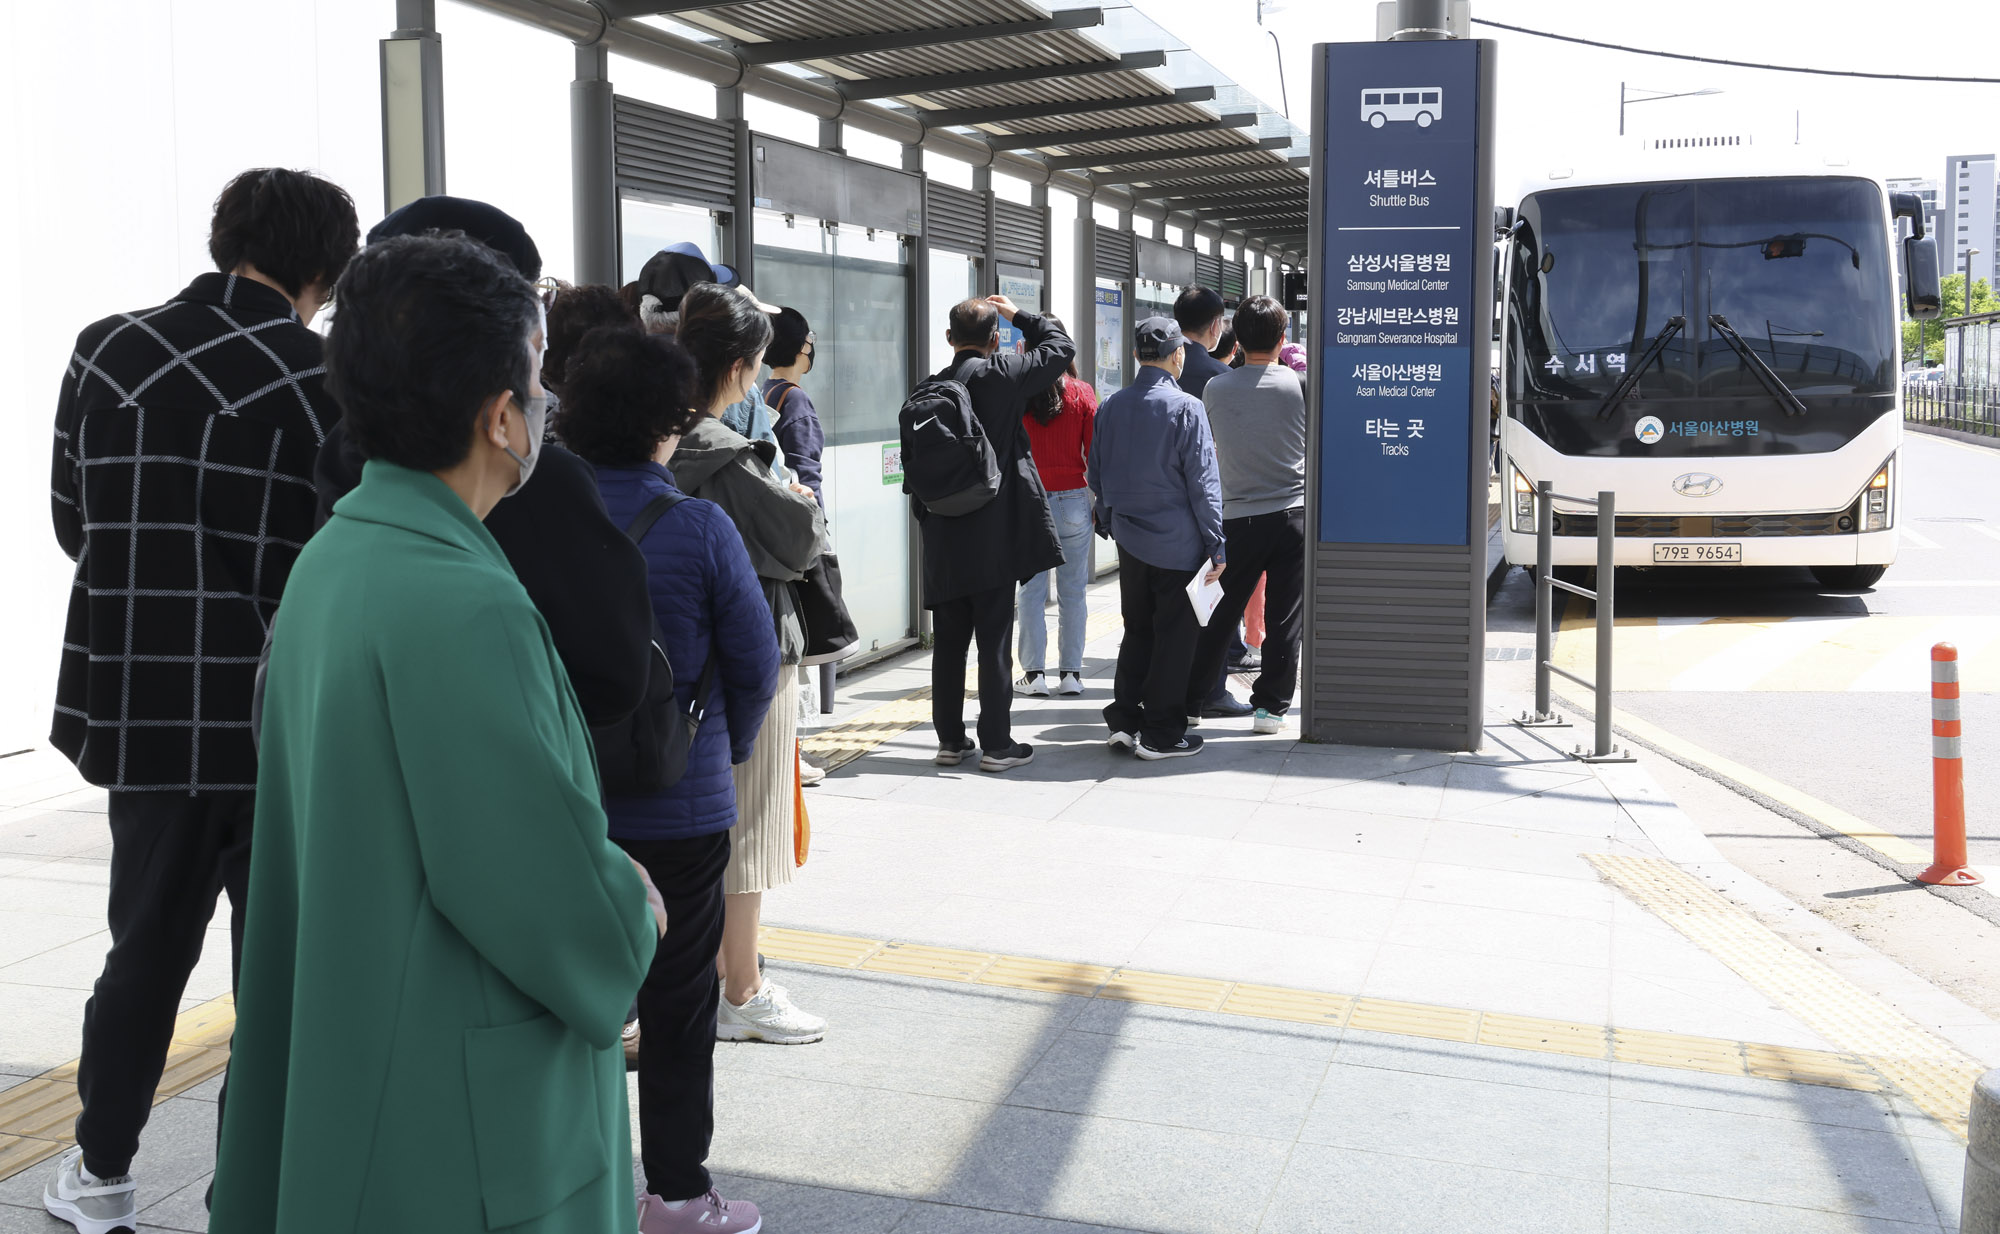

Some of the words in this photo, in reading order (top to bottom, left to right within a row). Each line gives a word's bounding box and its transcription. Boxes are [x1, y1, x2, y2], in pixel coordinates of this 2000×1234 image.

[1364, 169, 1437, 188] 셔틀버스
[1369, 194, 1406, 207] Shuttle
[1409, 194, 1430, 207] Bus
[1347, 253, 1451, 272] 삼성서울병원
[1346, 279, 1386, 293] Samsung
[1387, 279, 1420, 291] Medical
[1421, 279, 1449, 291] Center
[1336, 306, 1459, 326] 강남세브란스병원
[1336, 332, 1377, 346] Gangnam
[1378, 332, 1423, 344] Severance
[1424, 332, 1458, 346] Hospital
[1544, 353, 1626, 374] 수서역
[1352, 363, 1442, 382] 서울아산병원
[1356, 385, 1376, 397] Asan
[1378, 385, 1408, 397] Medical
[1410, 385, 1436, 397] Center
[1365, 418, 1400, 438] 타는
[1406, 419, 1425, 438] 곳
[1669, 420, 1759, 437] 서울아산병원
[1381, 443, 1410, 456] Tracks
[1662, 546, 1689, 560] 79모
[1696, 546, 1733, 560] 9654
